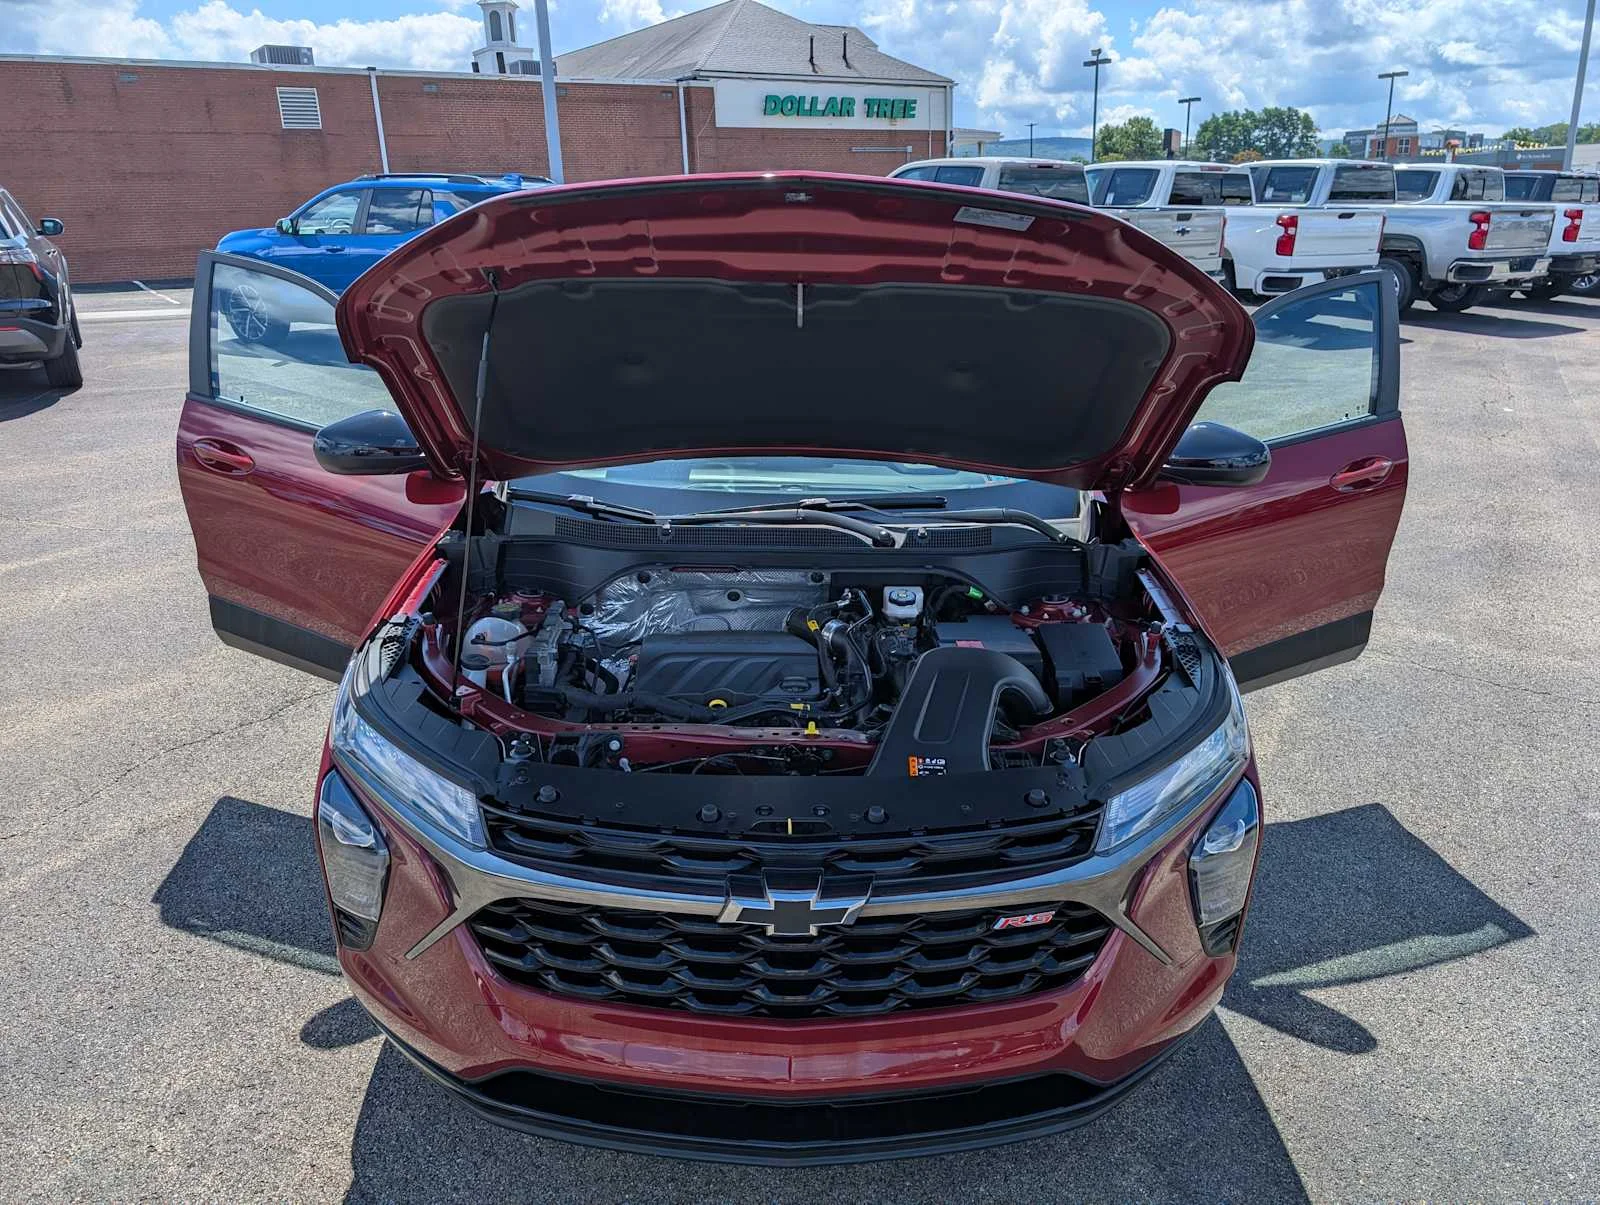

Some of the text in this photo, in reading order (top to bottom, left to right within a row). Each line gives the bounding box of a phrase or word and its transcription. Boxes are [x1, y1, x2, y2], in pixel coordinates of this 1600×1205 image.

[764, 94, 917, 119] DOLLAR TREE
[993, 911, 1056, 929] RS
